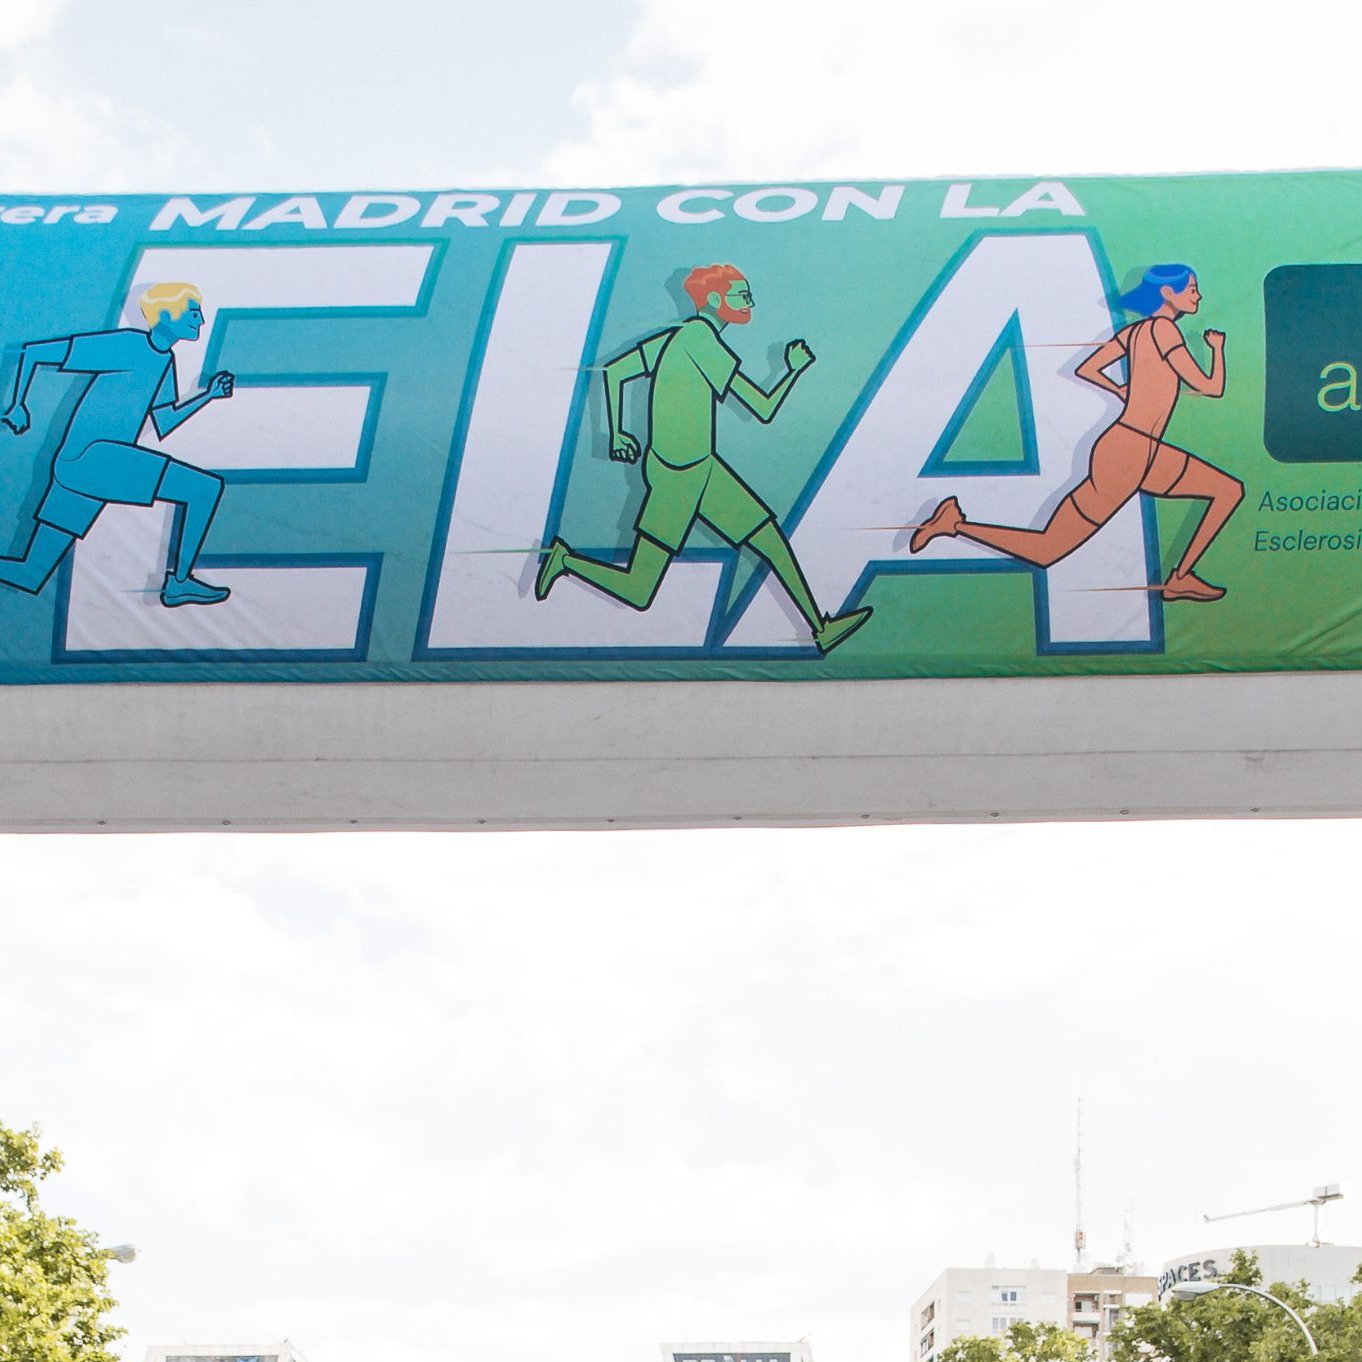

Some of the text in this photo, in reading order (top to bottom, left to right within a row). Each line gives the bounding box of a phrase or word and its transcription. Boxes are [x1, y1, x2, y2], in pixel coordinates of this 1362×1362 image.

[149, 193, 621, 232] MADRID
[655, 187, 906, 225] CON
[940, 182, 1086, 220] LA
[51, 227, 1167, 662] ELA
